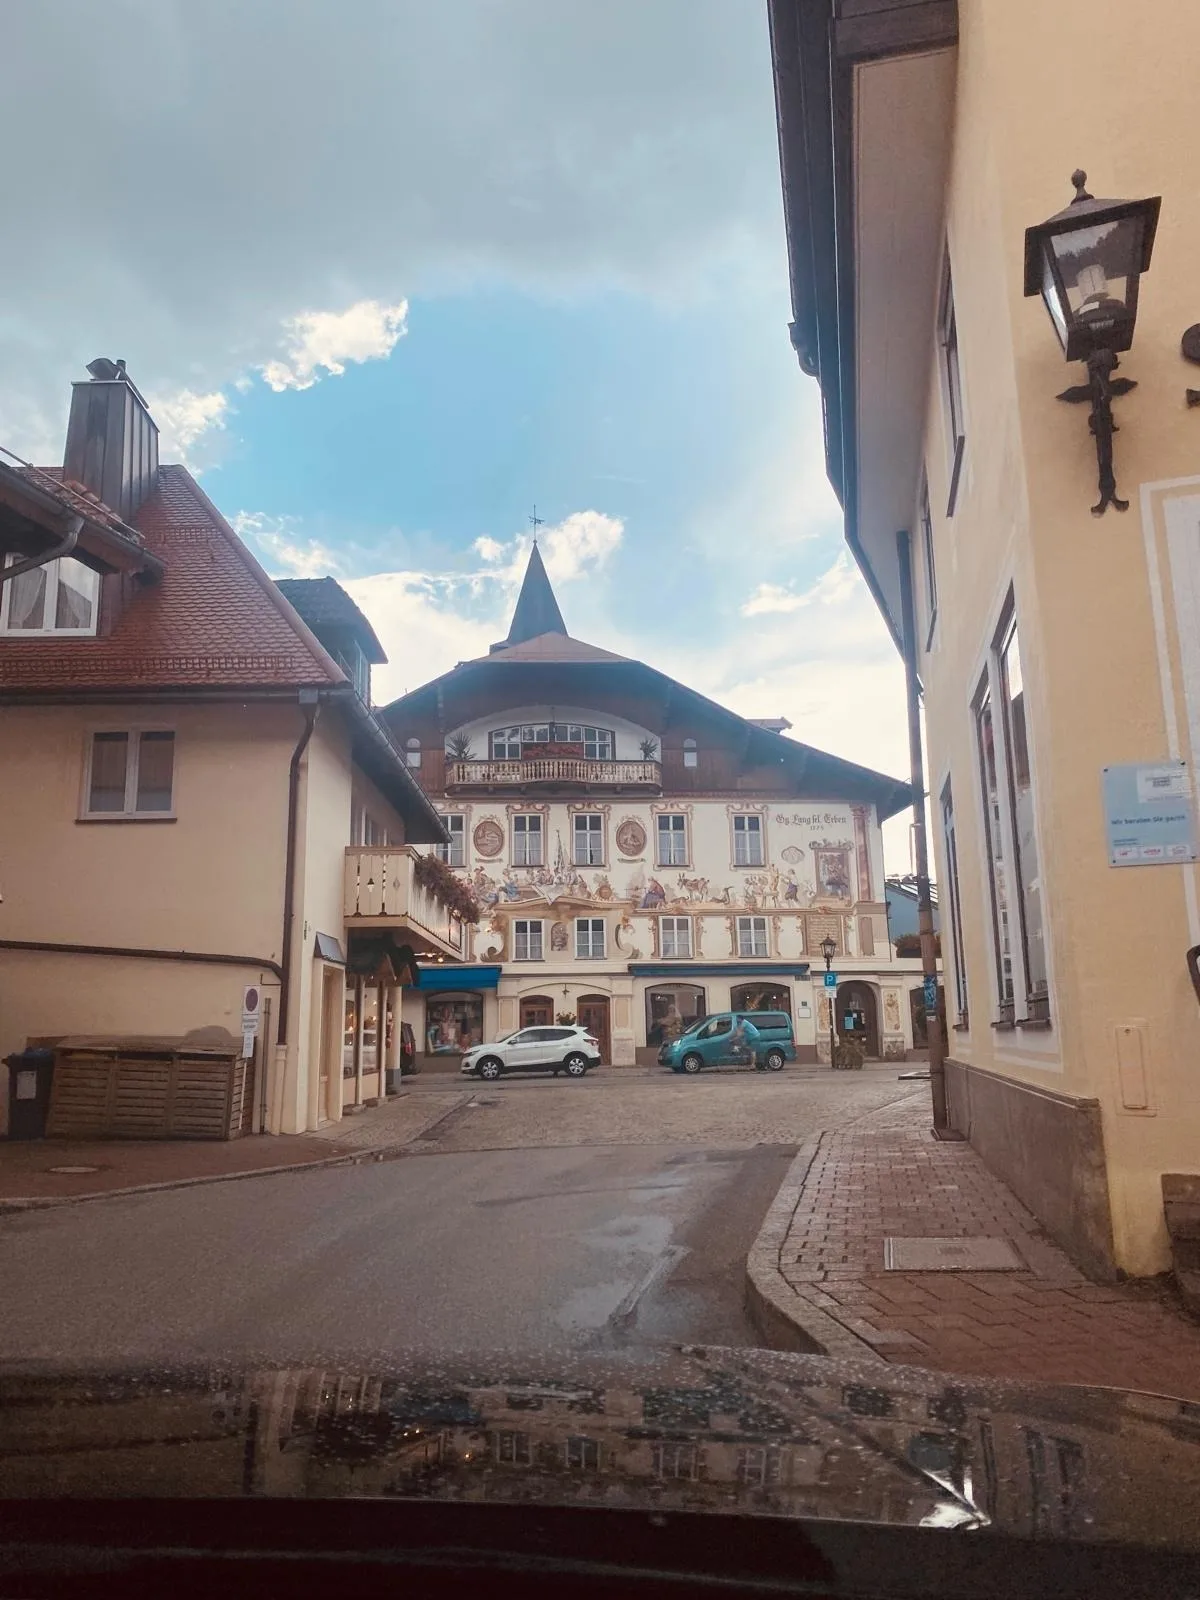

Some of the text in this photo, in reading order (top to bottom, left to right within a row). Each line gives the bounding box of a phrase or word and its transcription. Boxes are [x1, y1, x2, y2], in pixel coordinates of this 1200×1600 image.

[792, 813, 811, 826] Lang
[823, 813, 847, 824] Erben
[826, 975, 833, 986] P
